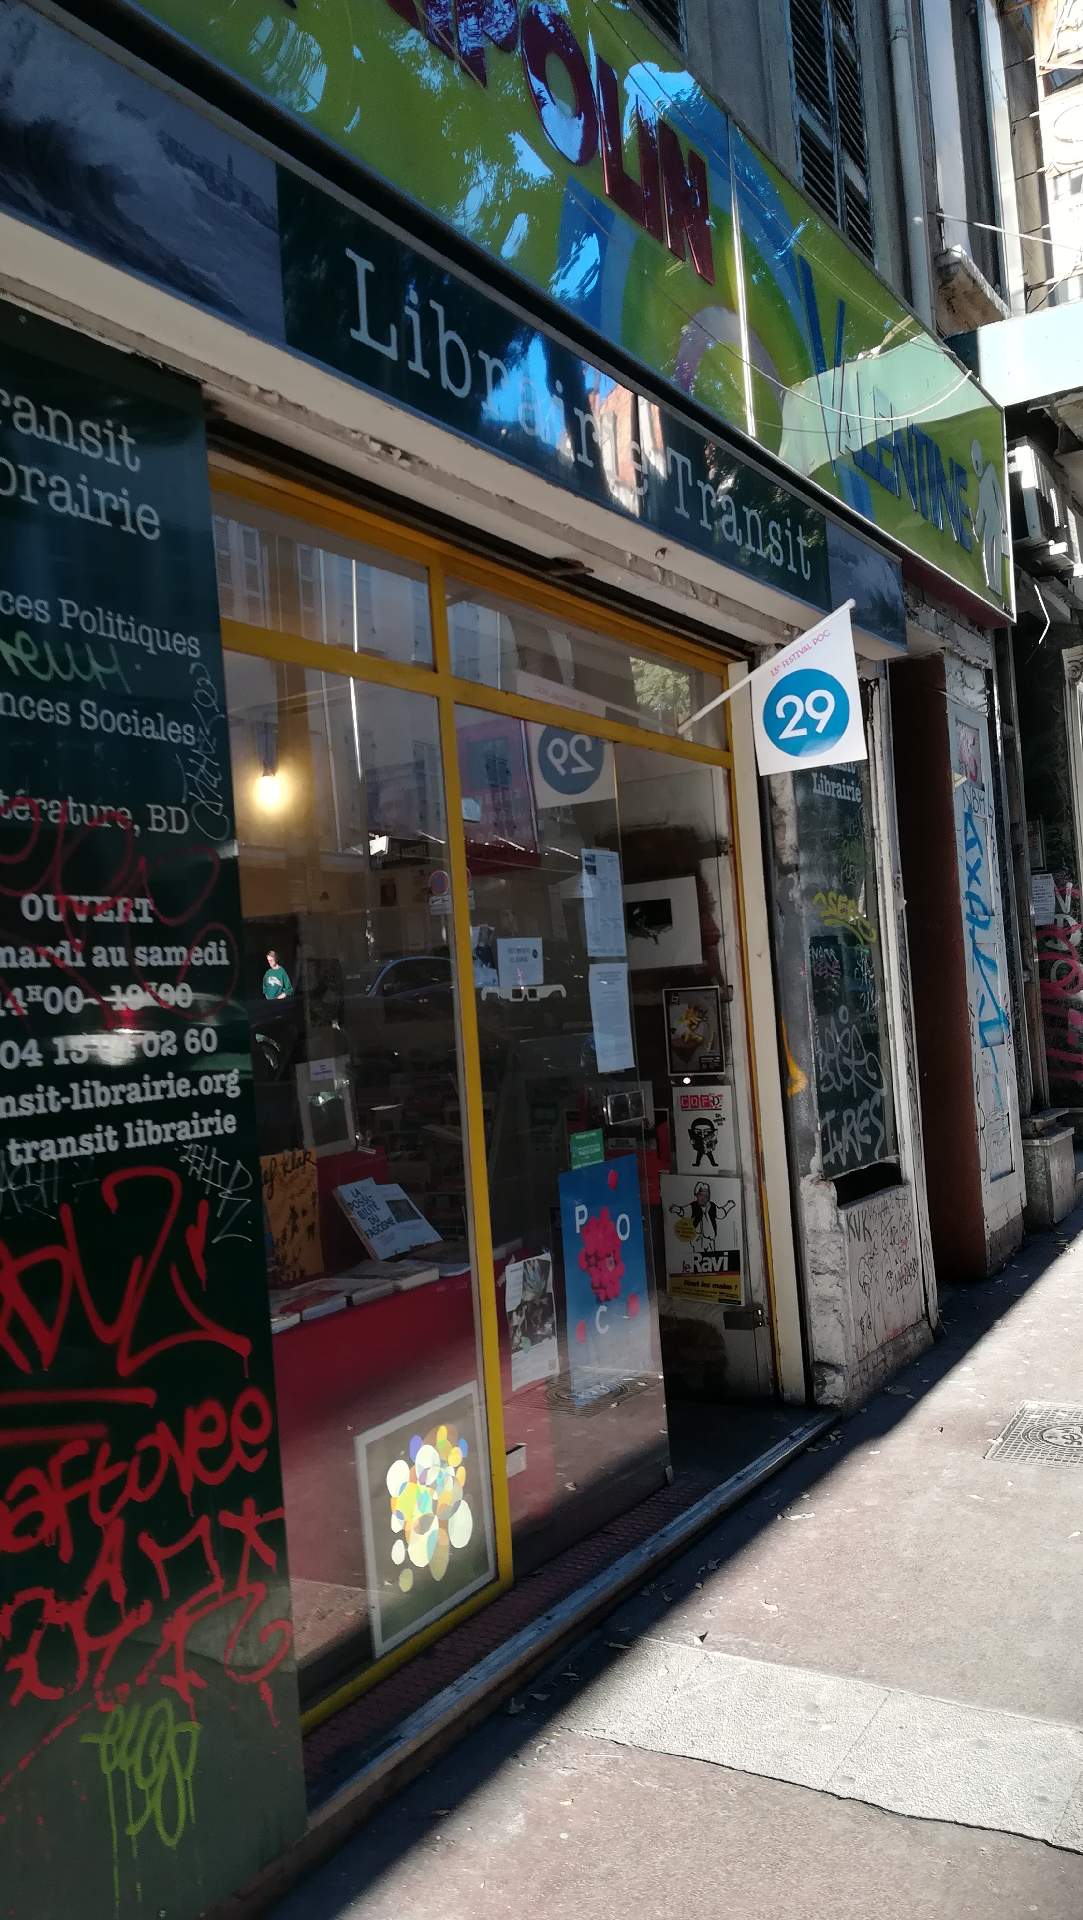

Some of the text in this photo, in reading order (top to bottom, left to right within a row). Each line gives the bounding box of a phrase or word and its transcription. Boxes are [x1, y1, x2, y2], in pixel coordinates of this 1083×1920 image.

[665, 446, 812, 582] Transit
[57, 598, 201, 658] Politiques
[79, 699, 197, 746] Sociales
[775, 689, 836, 741] 29
[811, 772, 863, 804] Librairie
[146, 803, 190, 835] BD
[92, 945, 129, 969] au
[134, 940, 230, 968] samedi
[0, 1038, 43, 1071] 04
[142, 1029, 178, 1059] 02
[184, 1027, 218, 1054] 60
[7, 1108, 237, 1167] transit librairie
